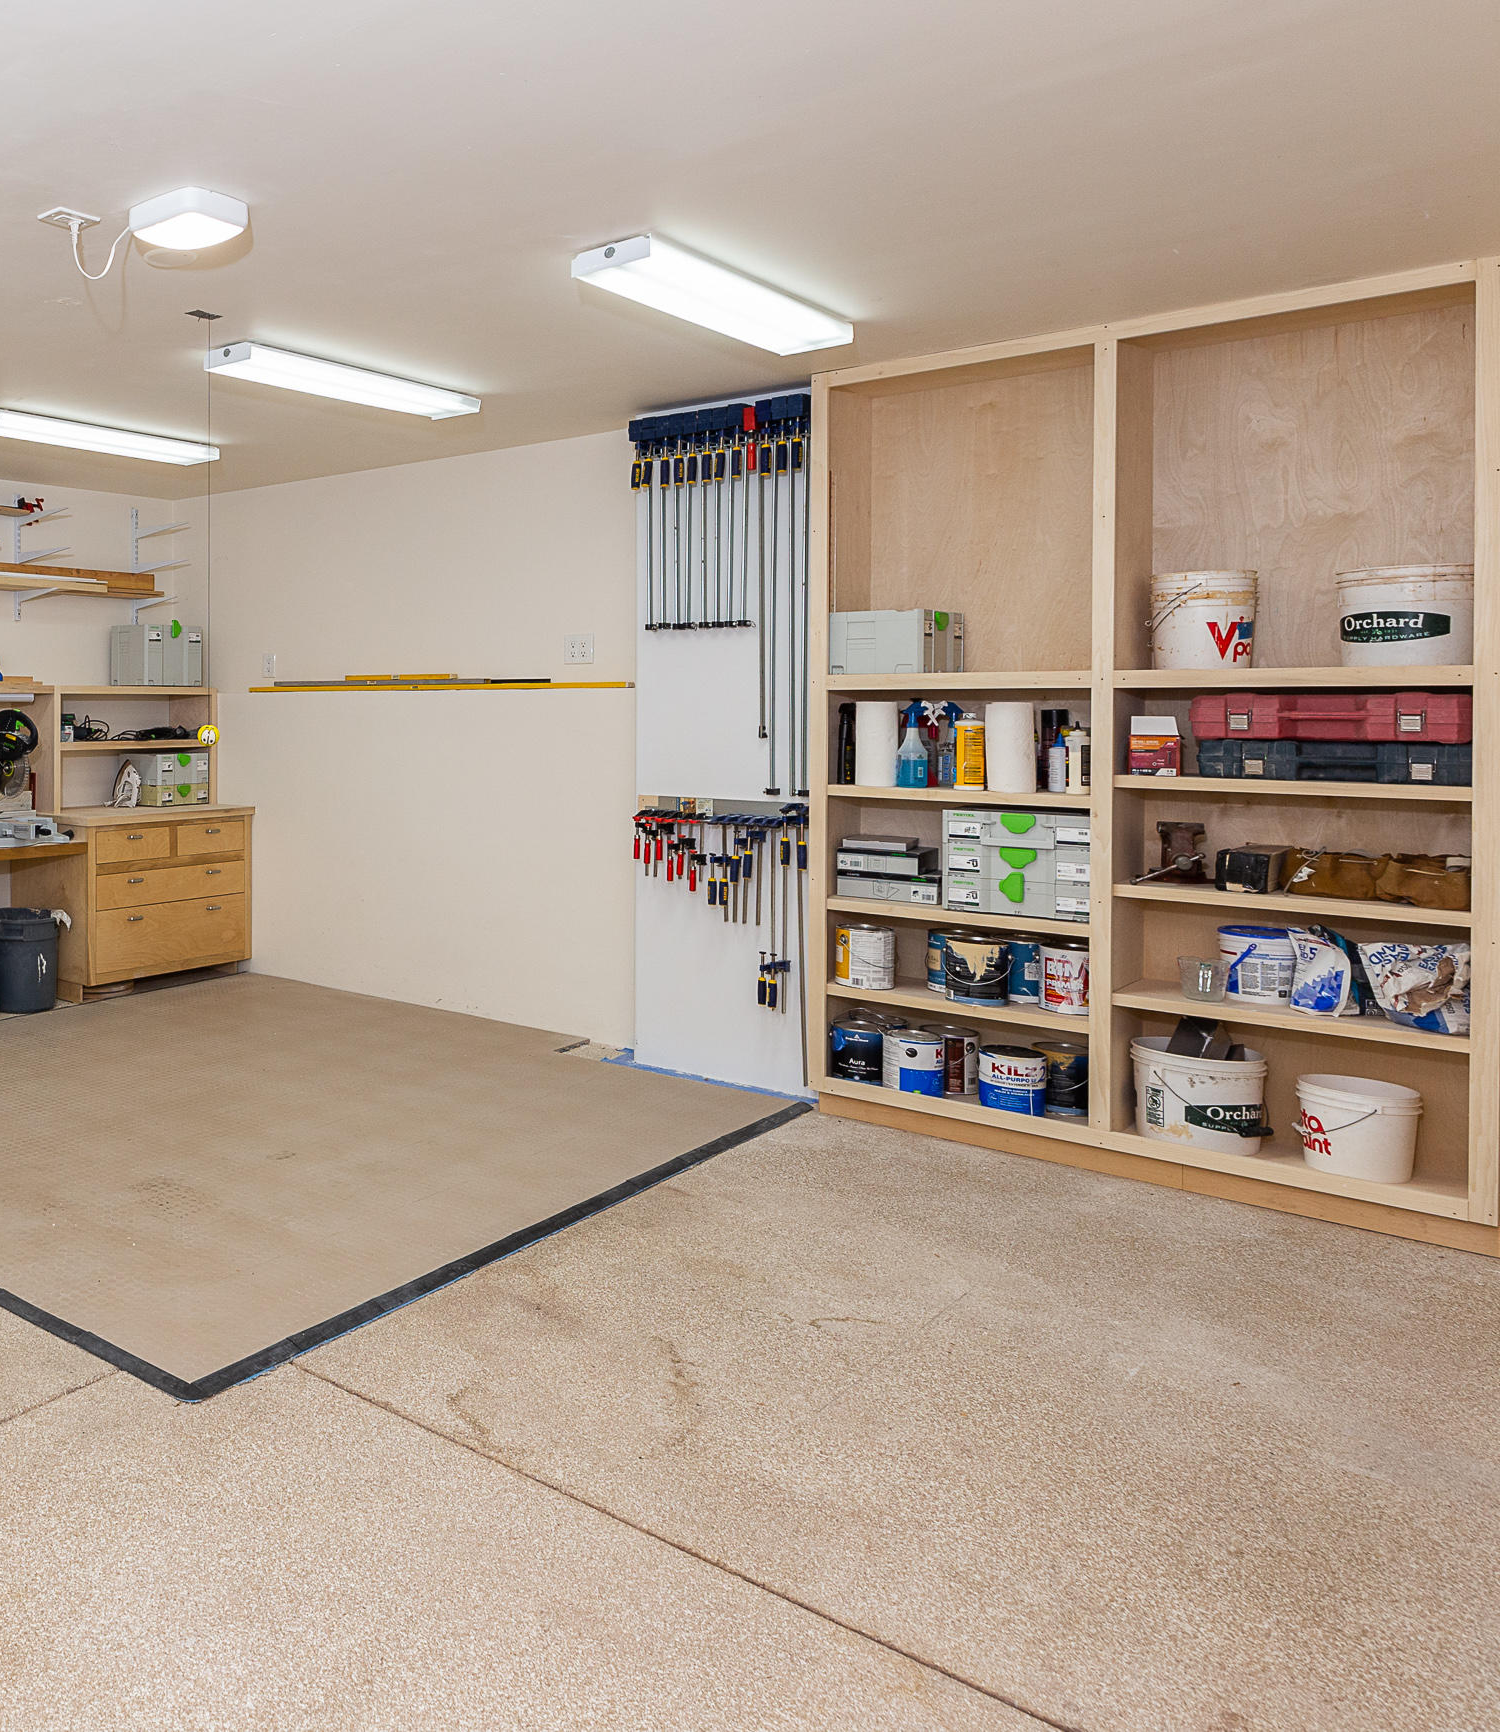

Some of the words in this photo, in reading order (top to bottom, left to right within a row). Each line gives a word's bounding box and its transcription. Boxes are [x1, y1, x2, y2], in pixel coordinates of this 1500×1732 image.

[1344, 614, 1424, 631] Orchard
[1370, 631, 1430, 641] HARDWARE
[849, 1057, 866, 1066] Aura
[991, 1062, 1038, 1078] KILZ
